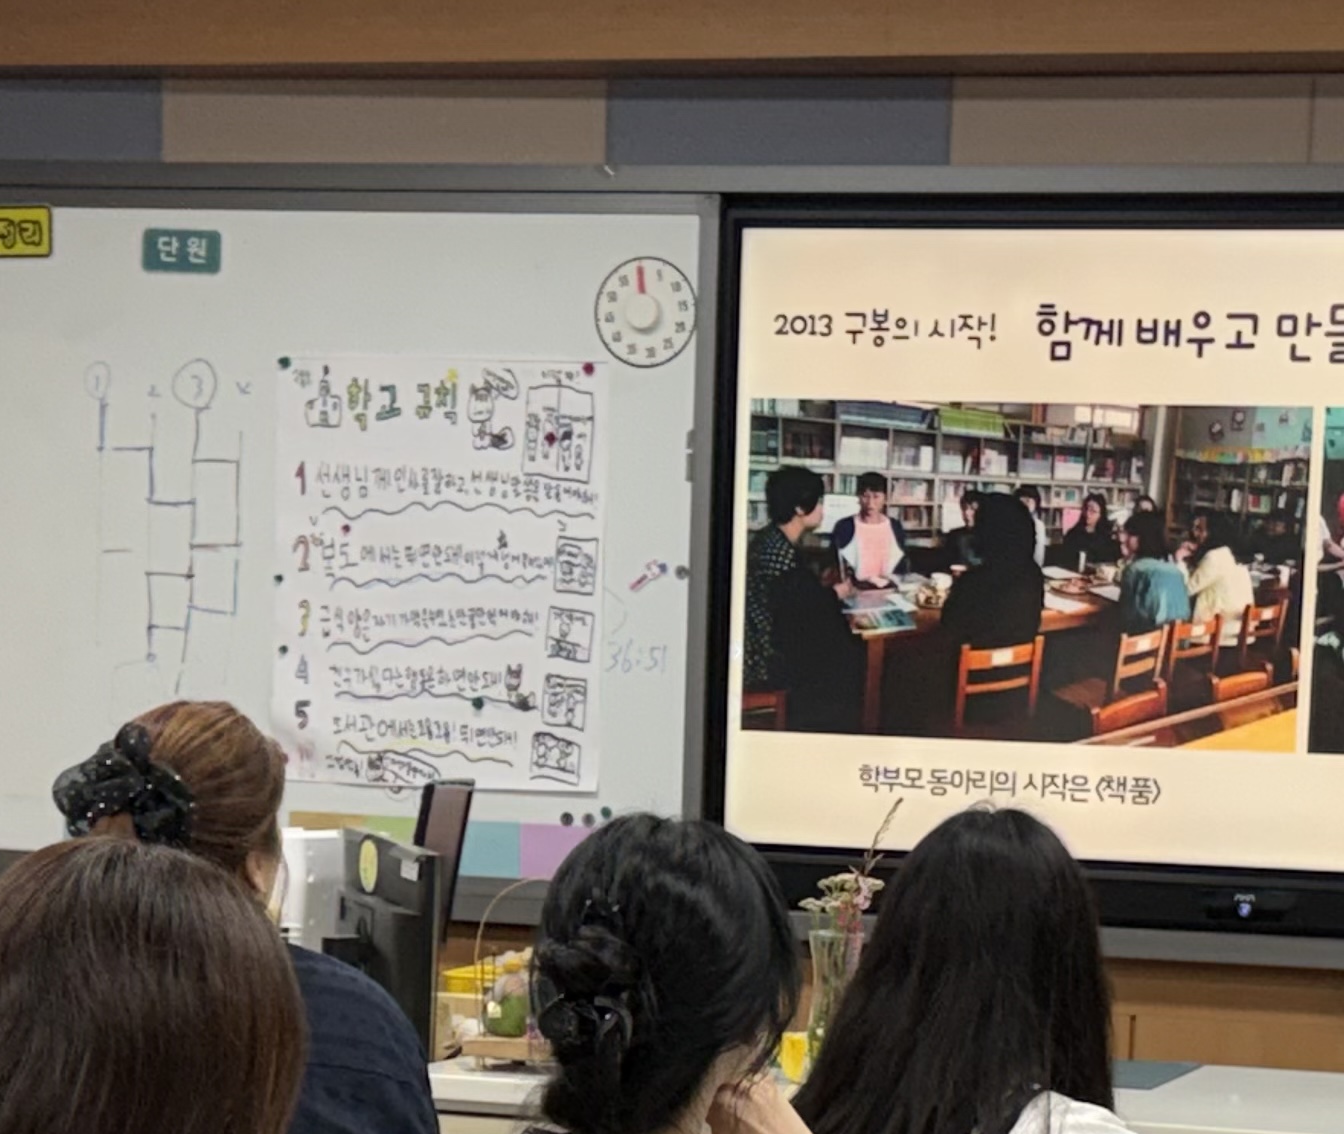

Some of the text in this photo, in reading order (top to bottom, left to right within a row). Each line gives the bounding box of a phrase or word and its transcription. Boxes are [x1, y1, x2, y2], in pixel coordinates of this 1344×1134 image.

[773, 308, 997, 350] 2013 구봉의 시작!
[1036, 303, 1124, 363] 함께
[1134, 309, 1260, 360] 배우고
[1022, 772, 1092, 803] 시작은
